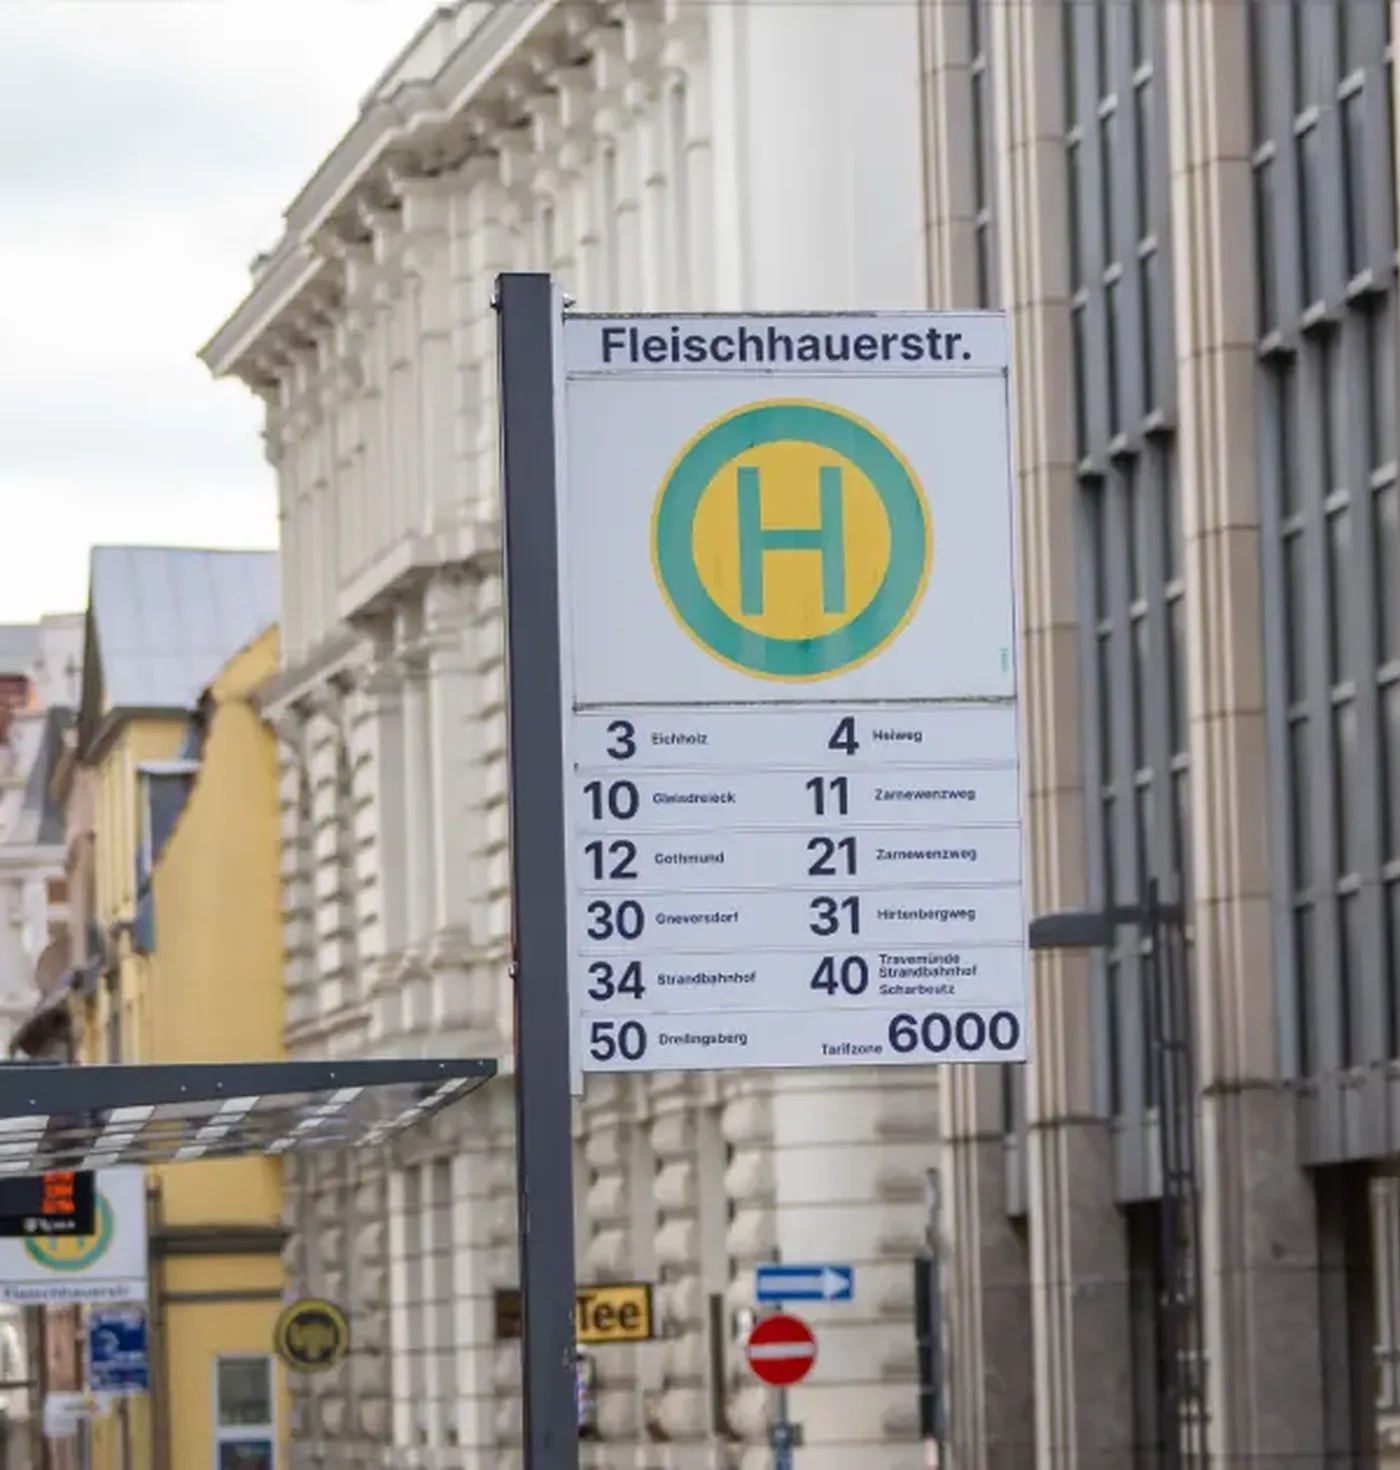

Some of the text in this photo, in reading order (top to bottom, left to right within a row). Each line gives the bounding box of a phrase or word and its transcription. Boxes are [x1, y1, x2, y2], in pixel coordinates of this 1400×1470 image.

[601, 325, 972, 364] Fleischhauerstr.
[736, 466, 846, 616] H
[606, 719, 708, 761] 3 Eichholz
[827, 716, 923, 756] 4 Heiweg
[583, 779, 640, 820] 10
[805, 776, 976, 816] 11 Zarnewenzweg
[584, 839, 725, 881] 12 Gothmund
[807, 836, 977, 876] 21 Zarnewenzweg
[586, 899, 739, 941] 30 Gneversdorf
[809, 895, 976, 937] 31 Hirtenbergweg
[810, 955, 869, 996] 40
[878, 952, 960, 965] Travemünde
[879, 965, 977, 979] Strandbahnhof
[586, 960, 756, 1002] 34 Strandbahnhof
[879, 983, 955, 996] Scharbeutz
[590, 1020, 647, 1062] 50
[820, 1011, 1020, 1056] Tarifzone 6000
[576, 1294, 641, 1332] Tee
